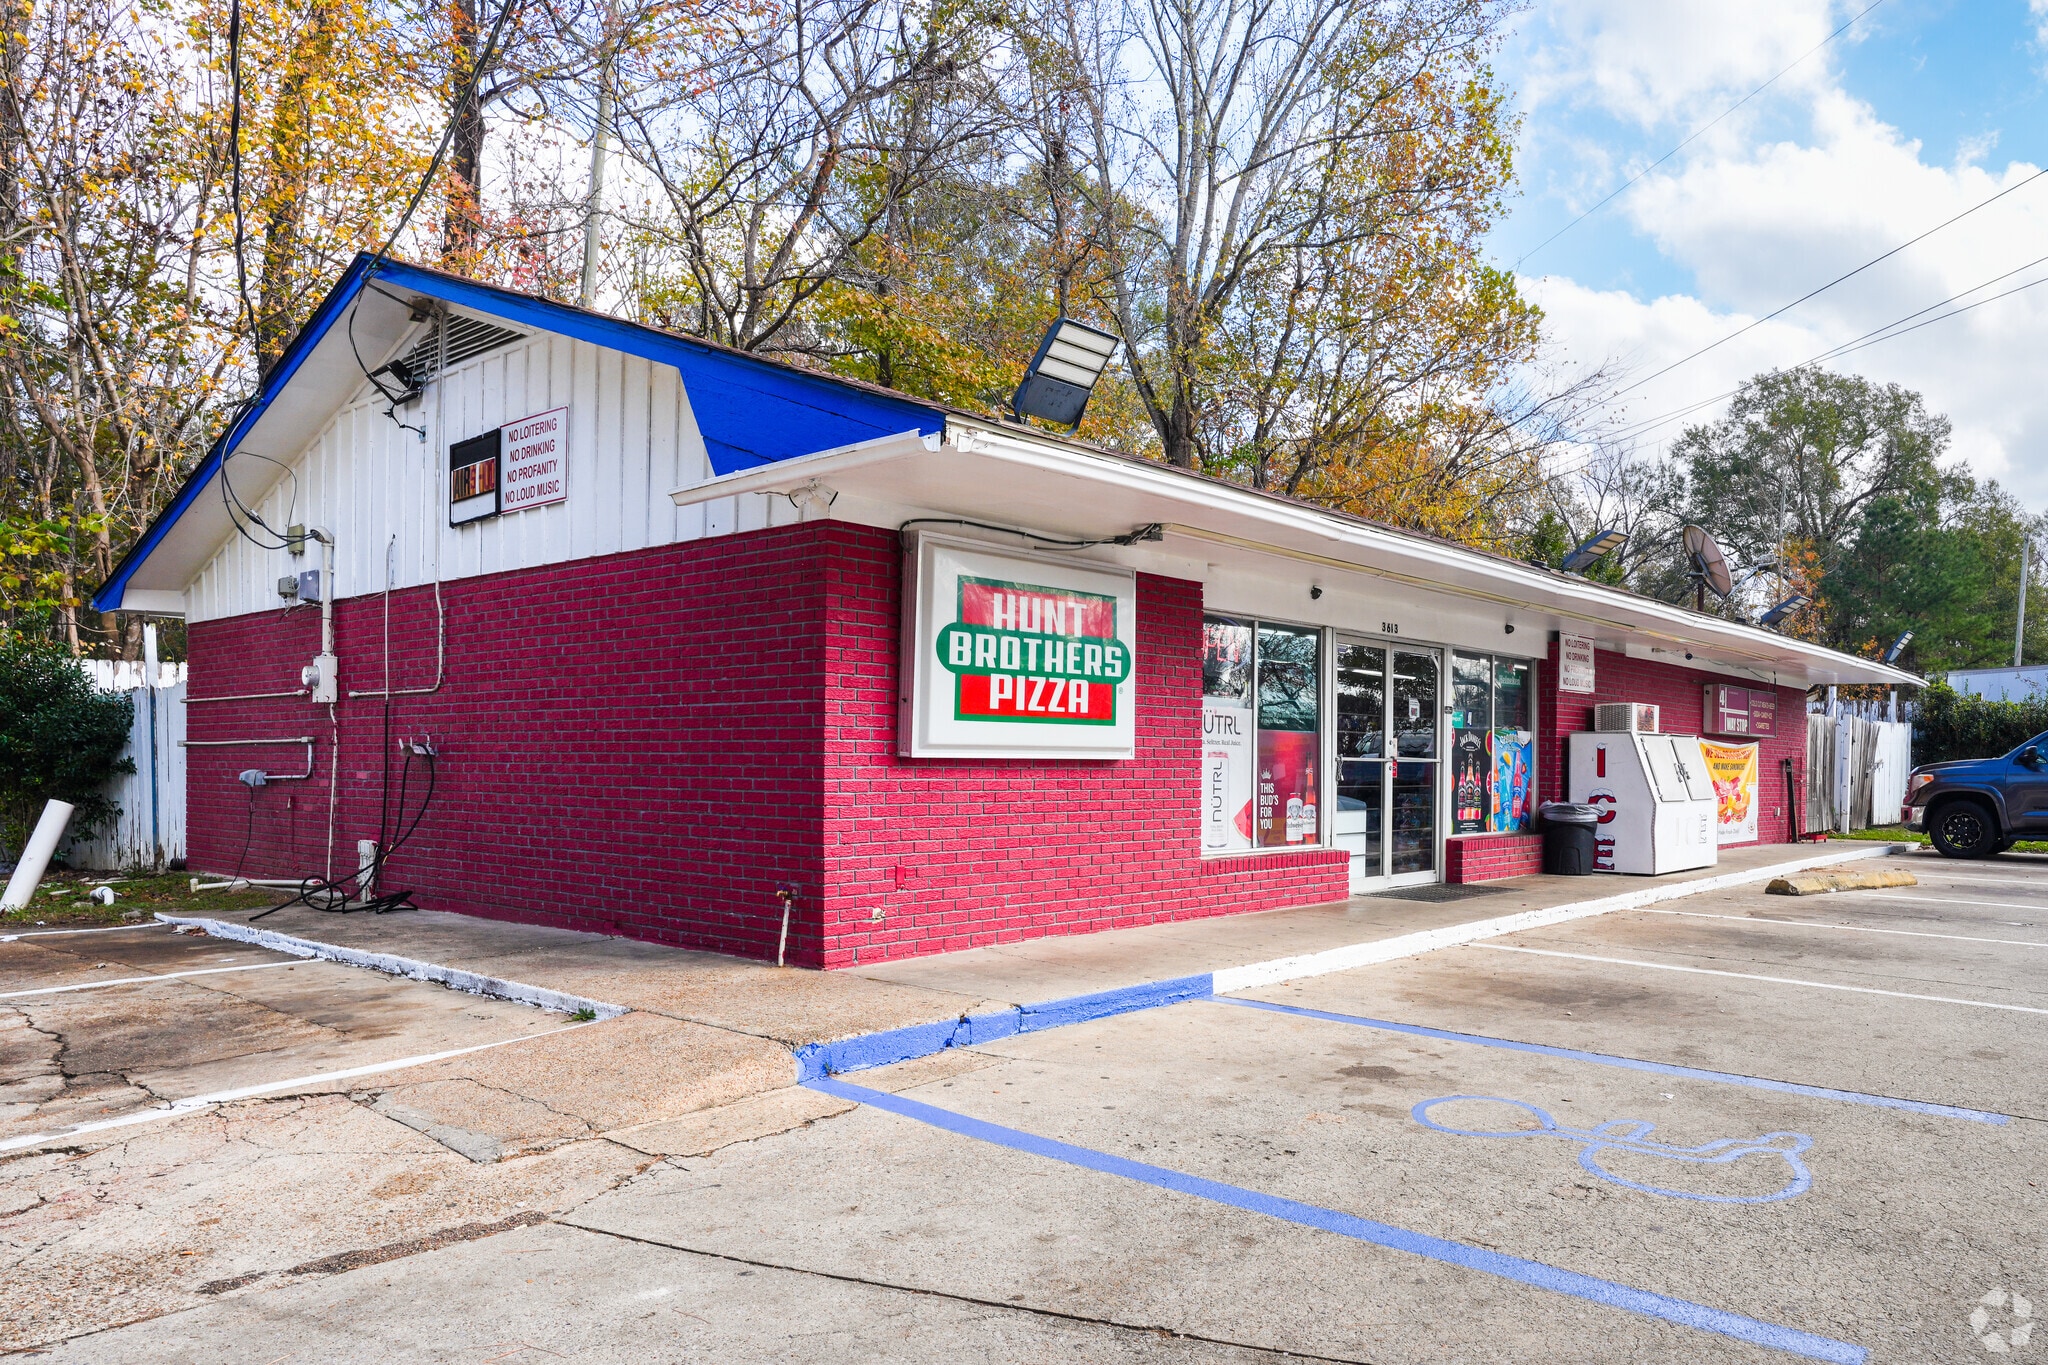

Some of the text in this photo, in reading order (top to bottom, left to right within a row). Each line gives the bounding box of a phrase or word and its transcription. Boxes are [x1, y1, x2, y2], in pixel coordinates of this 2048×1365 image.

[509, 418, 557, 444] NO LOITERING
[510, 439, 555, 463] NO DRINKING
[507, 459, 558, 484] NO PROFANITY
[505, 479, 560, 504] NO LOUD MUSIC
[993, 592, 1087, 638] HUNT
[1381, 622, 1398, 634] 3613
[1203, 627, 1241, 664] PEN
[1565, 639, 1590, 651] NO LOITERING
[948, 630, 1122, 677] BROTHERS
[1566, 652, 1589, 663] NO DRINKING
[1564, 664, 1570, 673] NO
[1563, 677, 1569, 686] NO
[1569, 677, 1579, 687] LOUD
[989, 673, 1089, 714] PIZZA
[1720, 690, 1725, 706] 4
[1203, 709, 1241, 735] ÜTRL
[1727, 717, 1748, 733] WAY STOP
[1260, 783, 1274, 794] THIS
[1260, 795, 1279, 806] BUD'S
[1586, 742, 1617, 871] ICE
[1260, 807, 1272, 818] FOR
[1260, 818, 1273, 830] YOU
